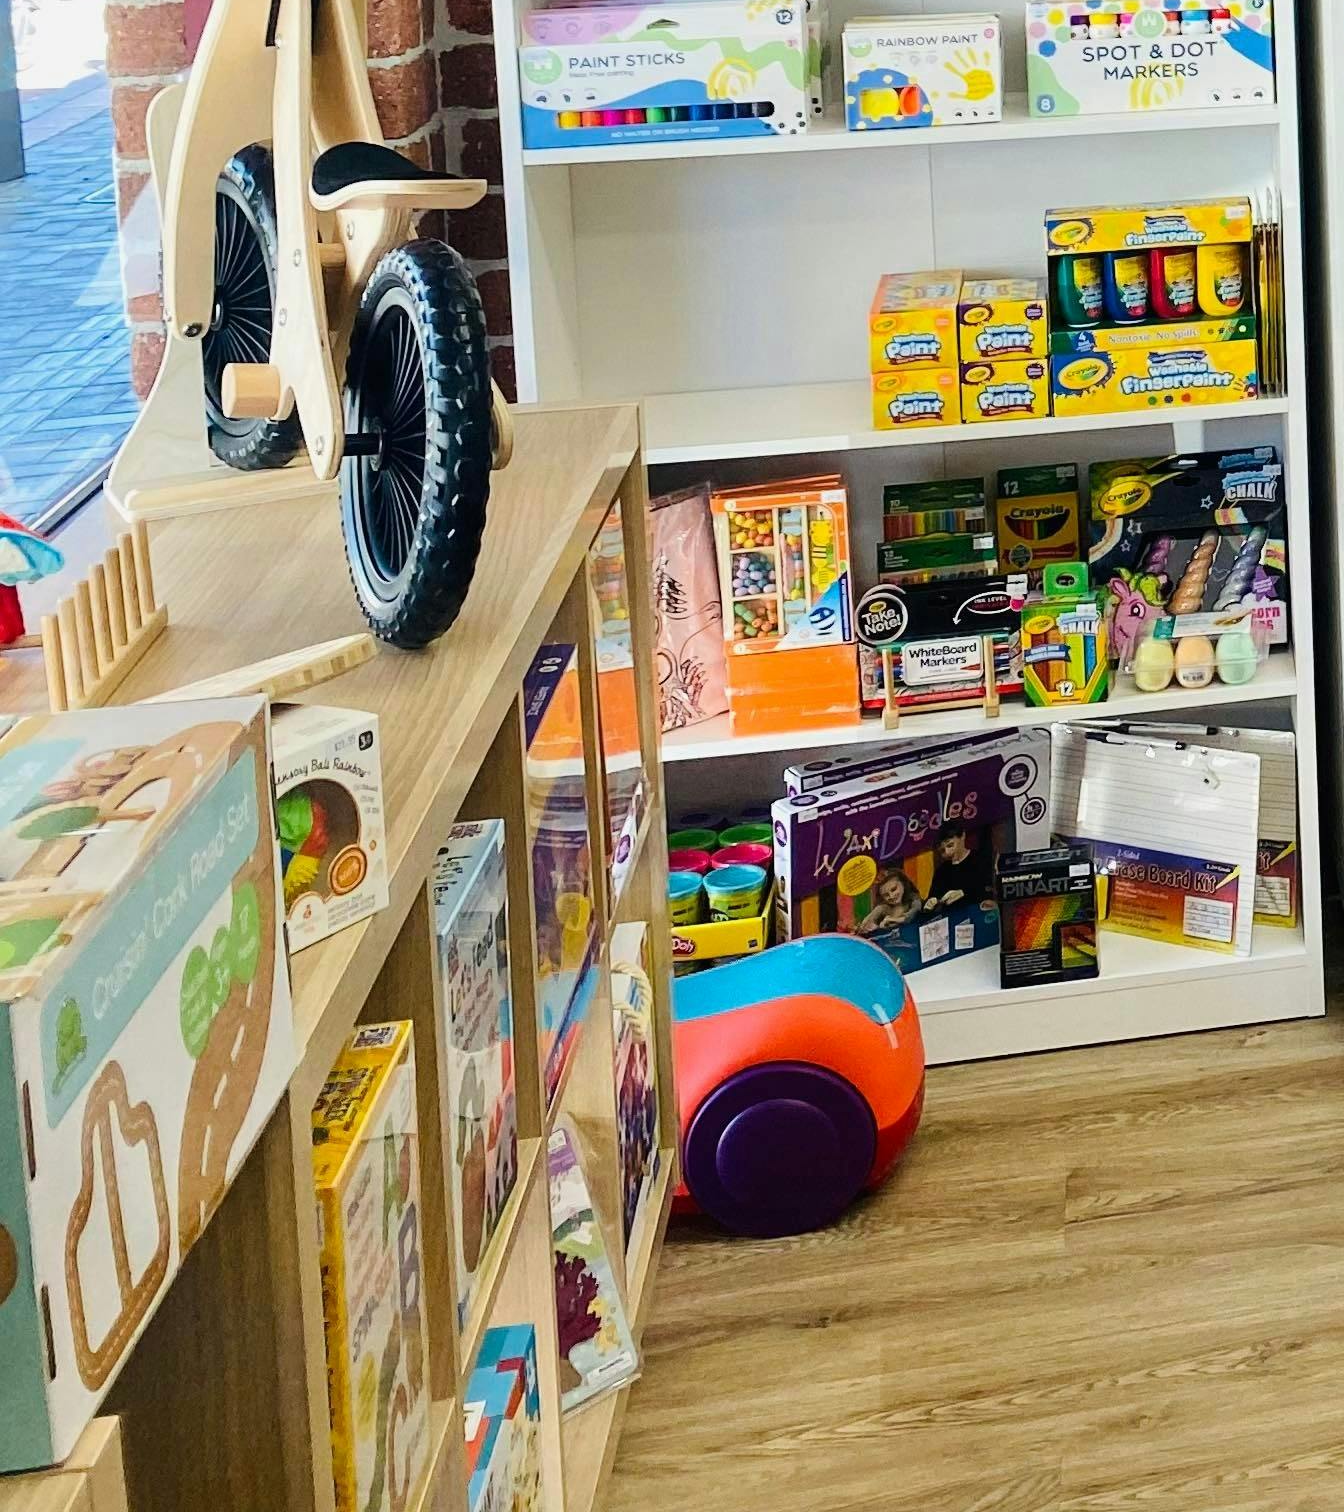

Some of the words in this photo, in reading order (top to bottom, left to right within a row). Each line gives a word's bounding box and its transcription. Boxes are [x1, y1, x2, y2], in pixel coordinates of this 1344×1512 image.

[877, 35, 938, 49] RAINBOW
[942, 33, 977, 45] PAINT
[1083, 44, 1139, 63] SPOT
[1149, 43, 1164, 60] &
[1171, 40, 1218, 58] DOT
[568, 55, 621, 70] PAINT
[626, 52, 687, 66] STICKS
[1103, 62, 1199, 81] MARKERS
[1040, 98, 1051, 111] 8
[976, 333, 1035, 352] Paint
[1156, 331, 1170, 340] No
[885, 341, 942, 360] Paint
[1148, 362, 1210, 377] Washable
[888, 399, 945, 418] Paint
[978, 392, 1037, 411] Paint
[1003, 480, 1021, 495] 12
[1107, 487, 1143, 504] Crayola
[1225, 481, 1276, 500] CHALK
[1010, 504, 1064, 520] Crayola
[861, 608, 896, 626] Take
[863, 618, 902, 637] Note!
[1060, 618, 1099, 635] CHALK
[908, 642, 978, 659] WhiteBoard
[919, 654, 968, 667] Markers
[1057, 680, 1073, 697] 12
[332, 756, 368, 779] Rainbow
[189, 831, 226, 891] Road
[226, 790, 250, 845] Set
[1003, 877, 1071, 899] PINART
[1149, 863, 1191, 890] Board
[1194, 872, 1217, 895] Kit
